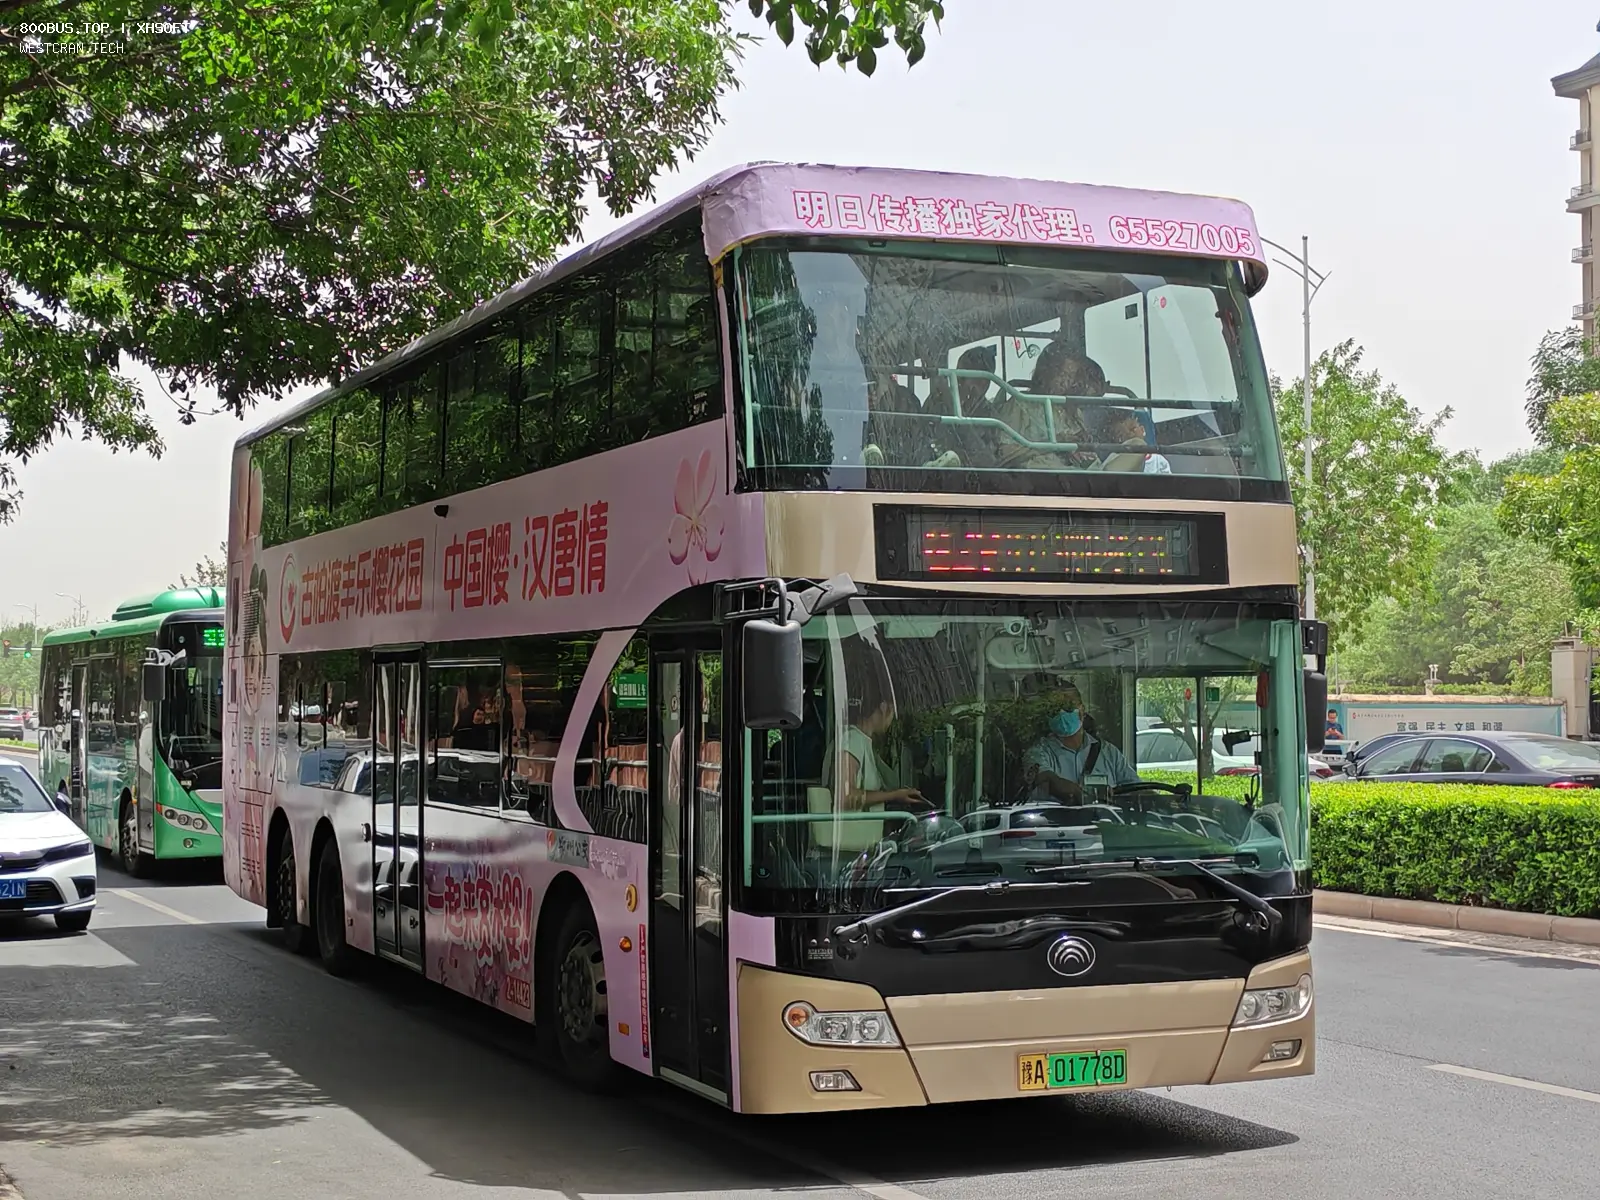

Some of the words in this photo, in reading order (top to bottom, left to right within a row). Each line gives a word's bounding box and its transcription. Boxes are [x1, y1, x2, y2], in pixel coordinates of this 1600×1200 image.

[1108, 214, 1256, 256] 65527005
[300, 537, 425, 626] 古柏渡丰乐樱花园
[1426, 721, 1446, 732] 民主
[1454, 721, 1475, 732] 文明
[1054, 1054, 1125, 1082] 01778D
